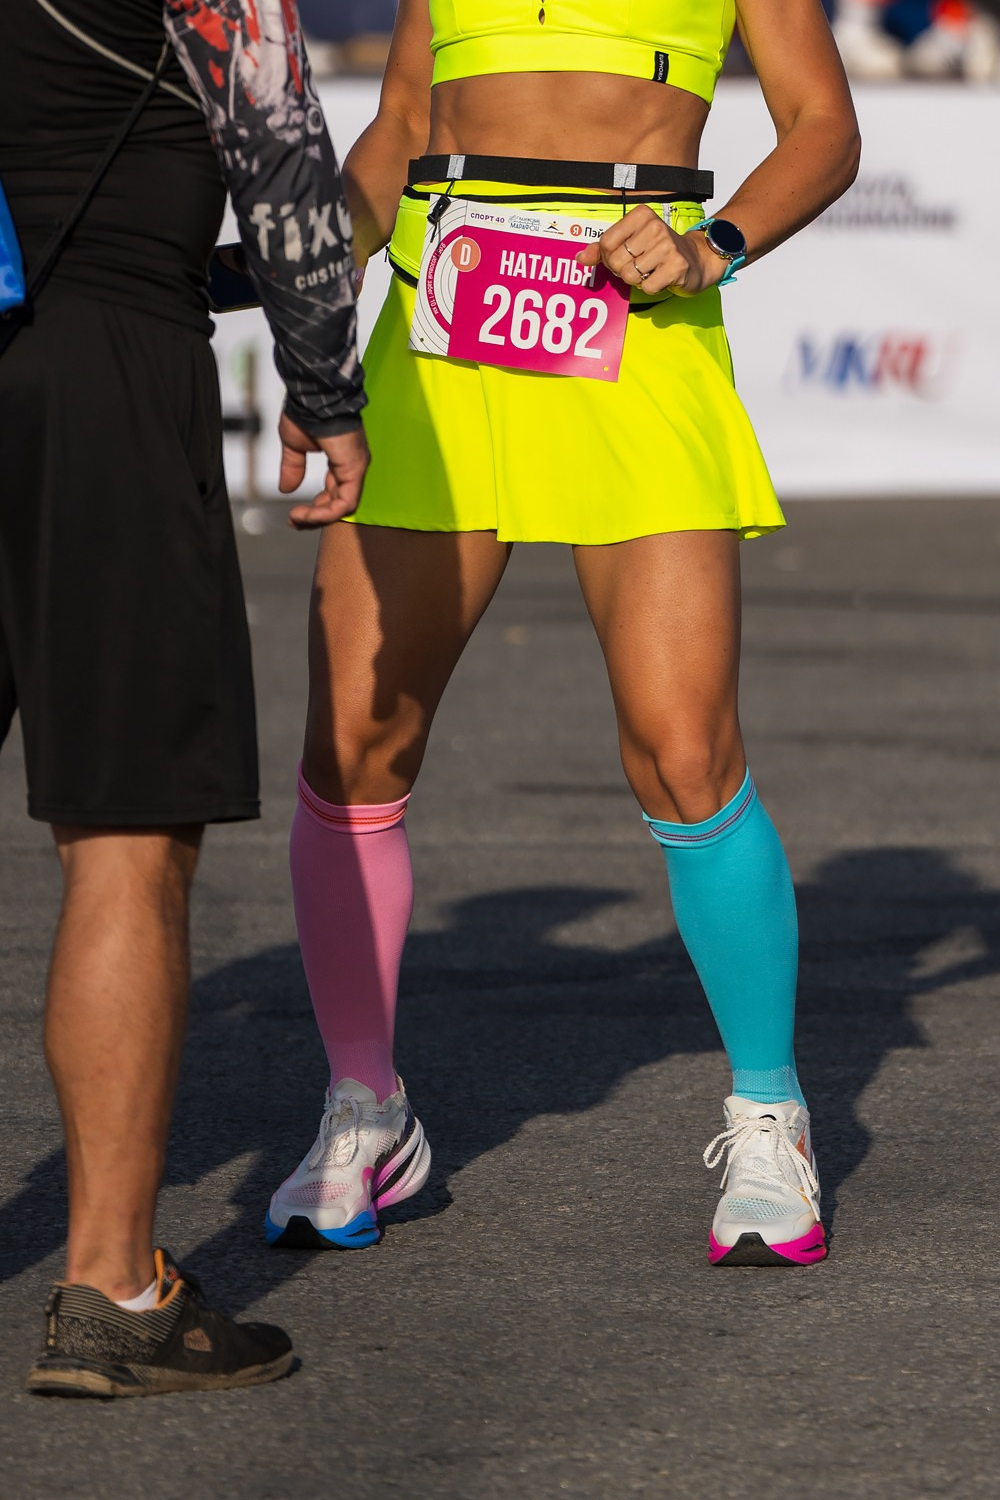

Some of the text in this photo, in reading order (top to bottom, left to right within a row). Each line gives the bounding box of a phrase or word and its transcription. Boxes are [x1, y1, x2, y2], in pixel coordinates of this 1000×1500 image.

[470, 212, 494, 222] СПОРТ
[495, 216, 505, 224] 40
[459, 243, 472, 267] D
[500, 250, 596, 288] НАТАЛЬЯ
[478, 284, 608, 359] 2682
